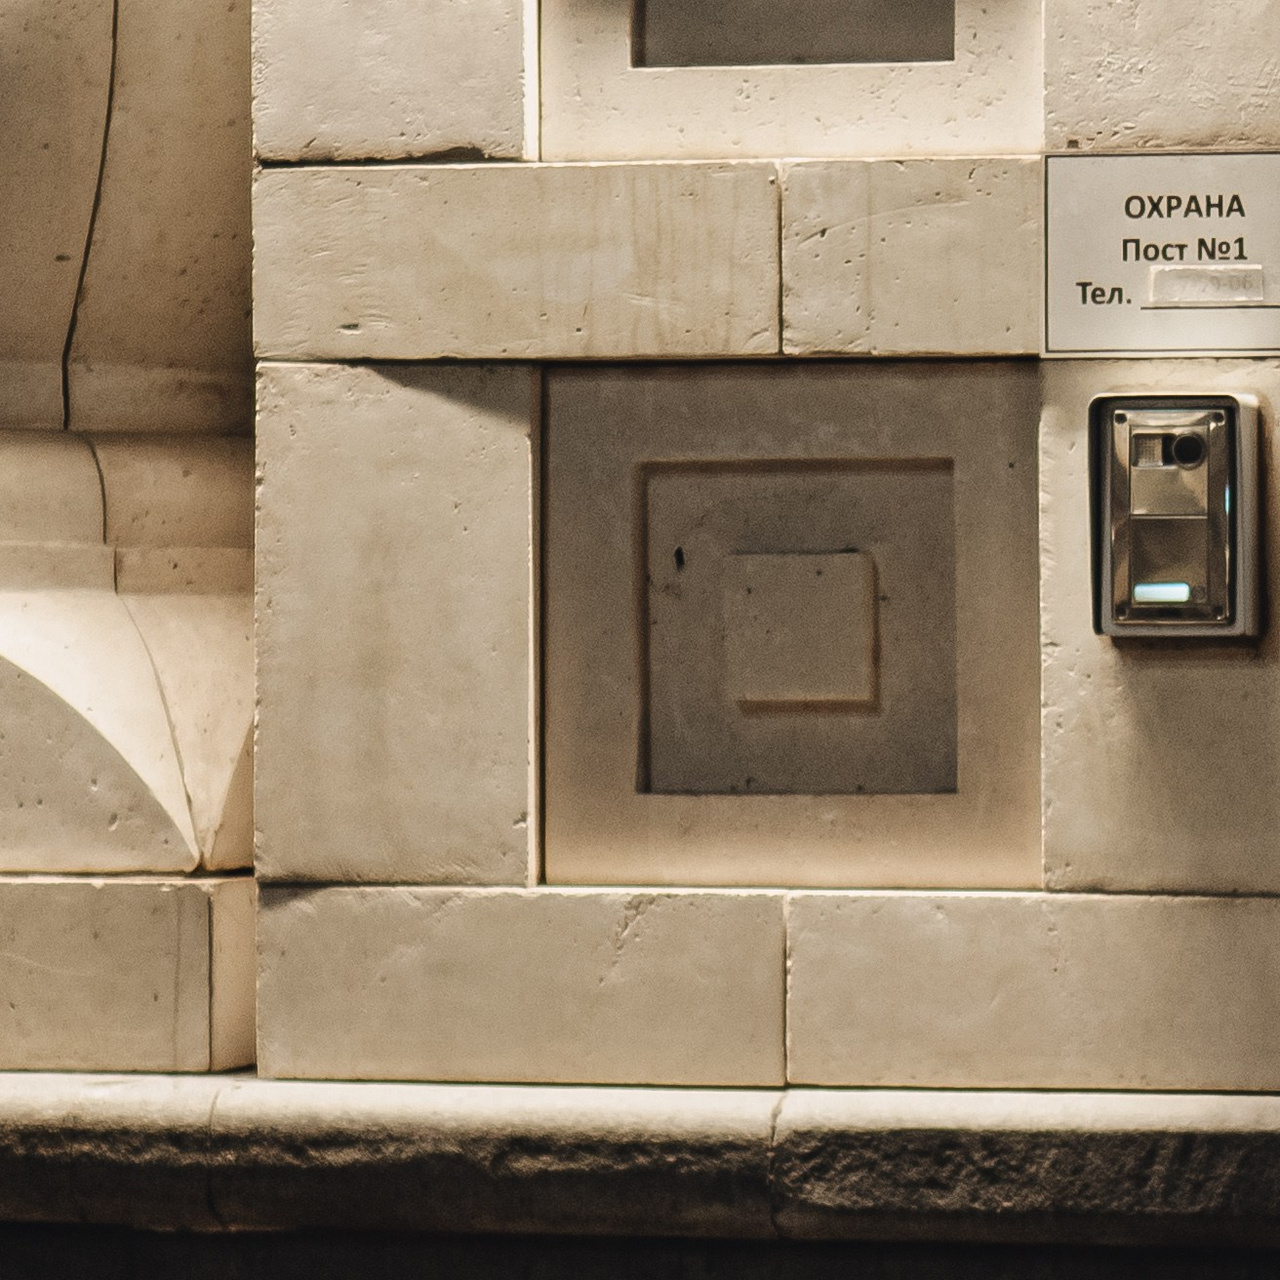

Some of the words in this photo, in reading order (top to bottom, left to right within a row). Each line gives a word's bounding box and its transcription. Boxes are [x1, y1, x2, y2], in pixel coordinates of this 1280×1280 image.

[1124, 194, 1246, 219] ОХРАНА
[1122, 238, 1188, 262] Пост
[1197, 237, 1248, 261] №1
[1075, 281, 1132, 305] Тел.
